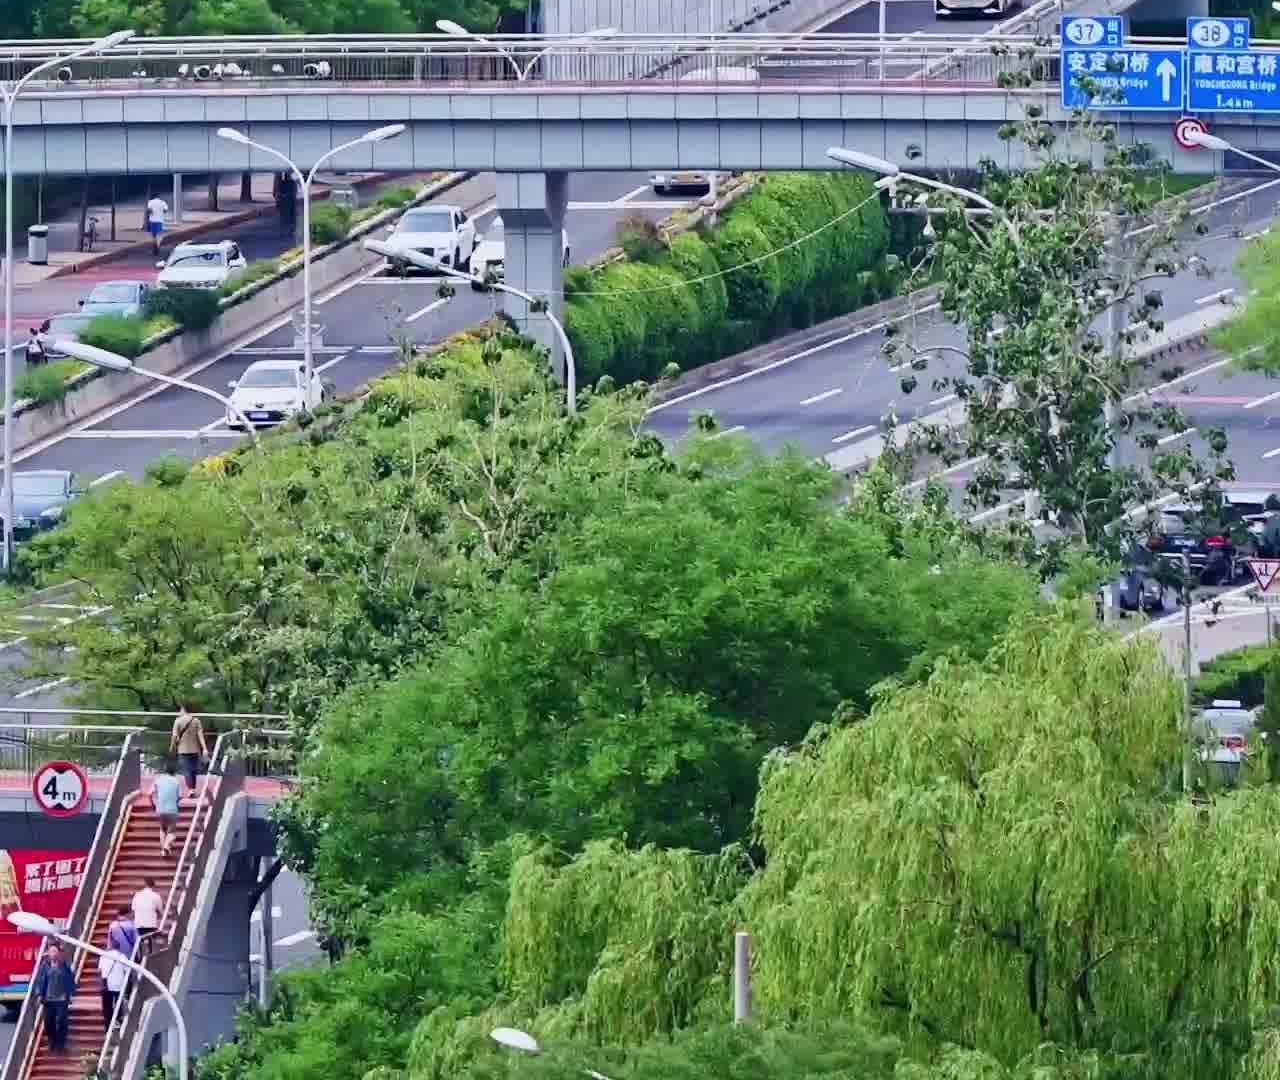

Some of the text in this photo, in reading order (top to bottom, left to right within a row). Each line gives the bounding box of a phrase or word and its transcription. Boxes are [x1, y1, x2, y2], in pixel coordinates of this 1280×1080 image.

[1074, 24, 1094, 41] 37
[1107, 19, 1118, 44] 出口
[1200, 25, 1221, 42] 38
[1233, 23, 1245, 47] 出口
[1067, 51, 1150, 72] 安定门桥
[1194, 54, 1278, 76] 雍和宫桥
